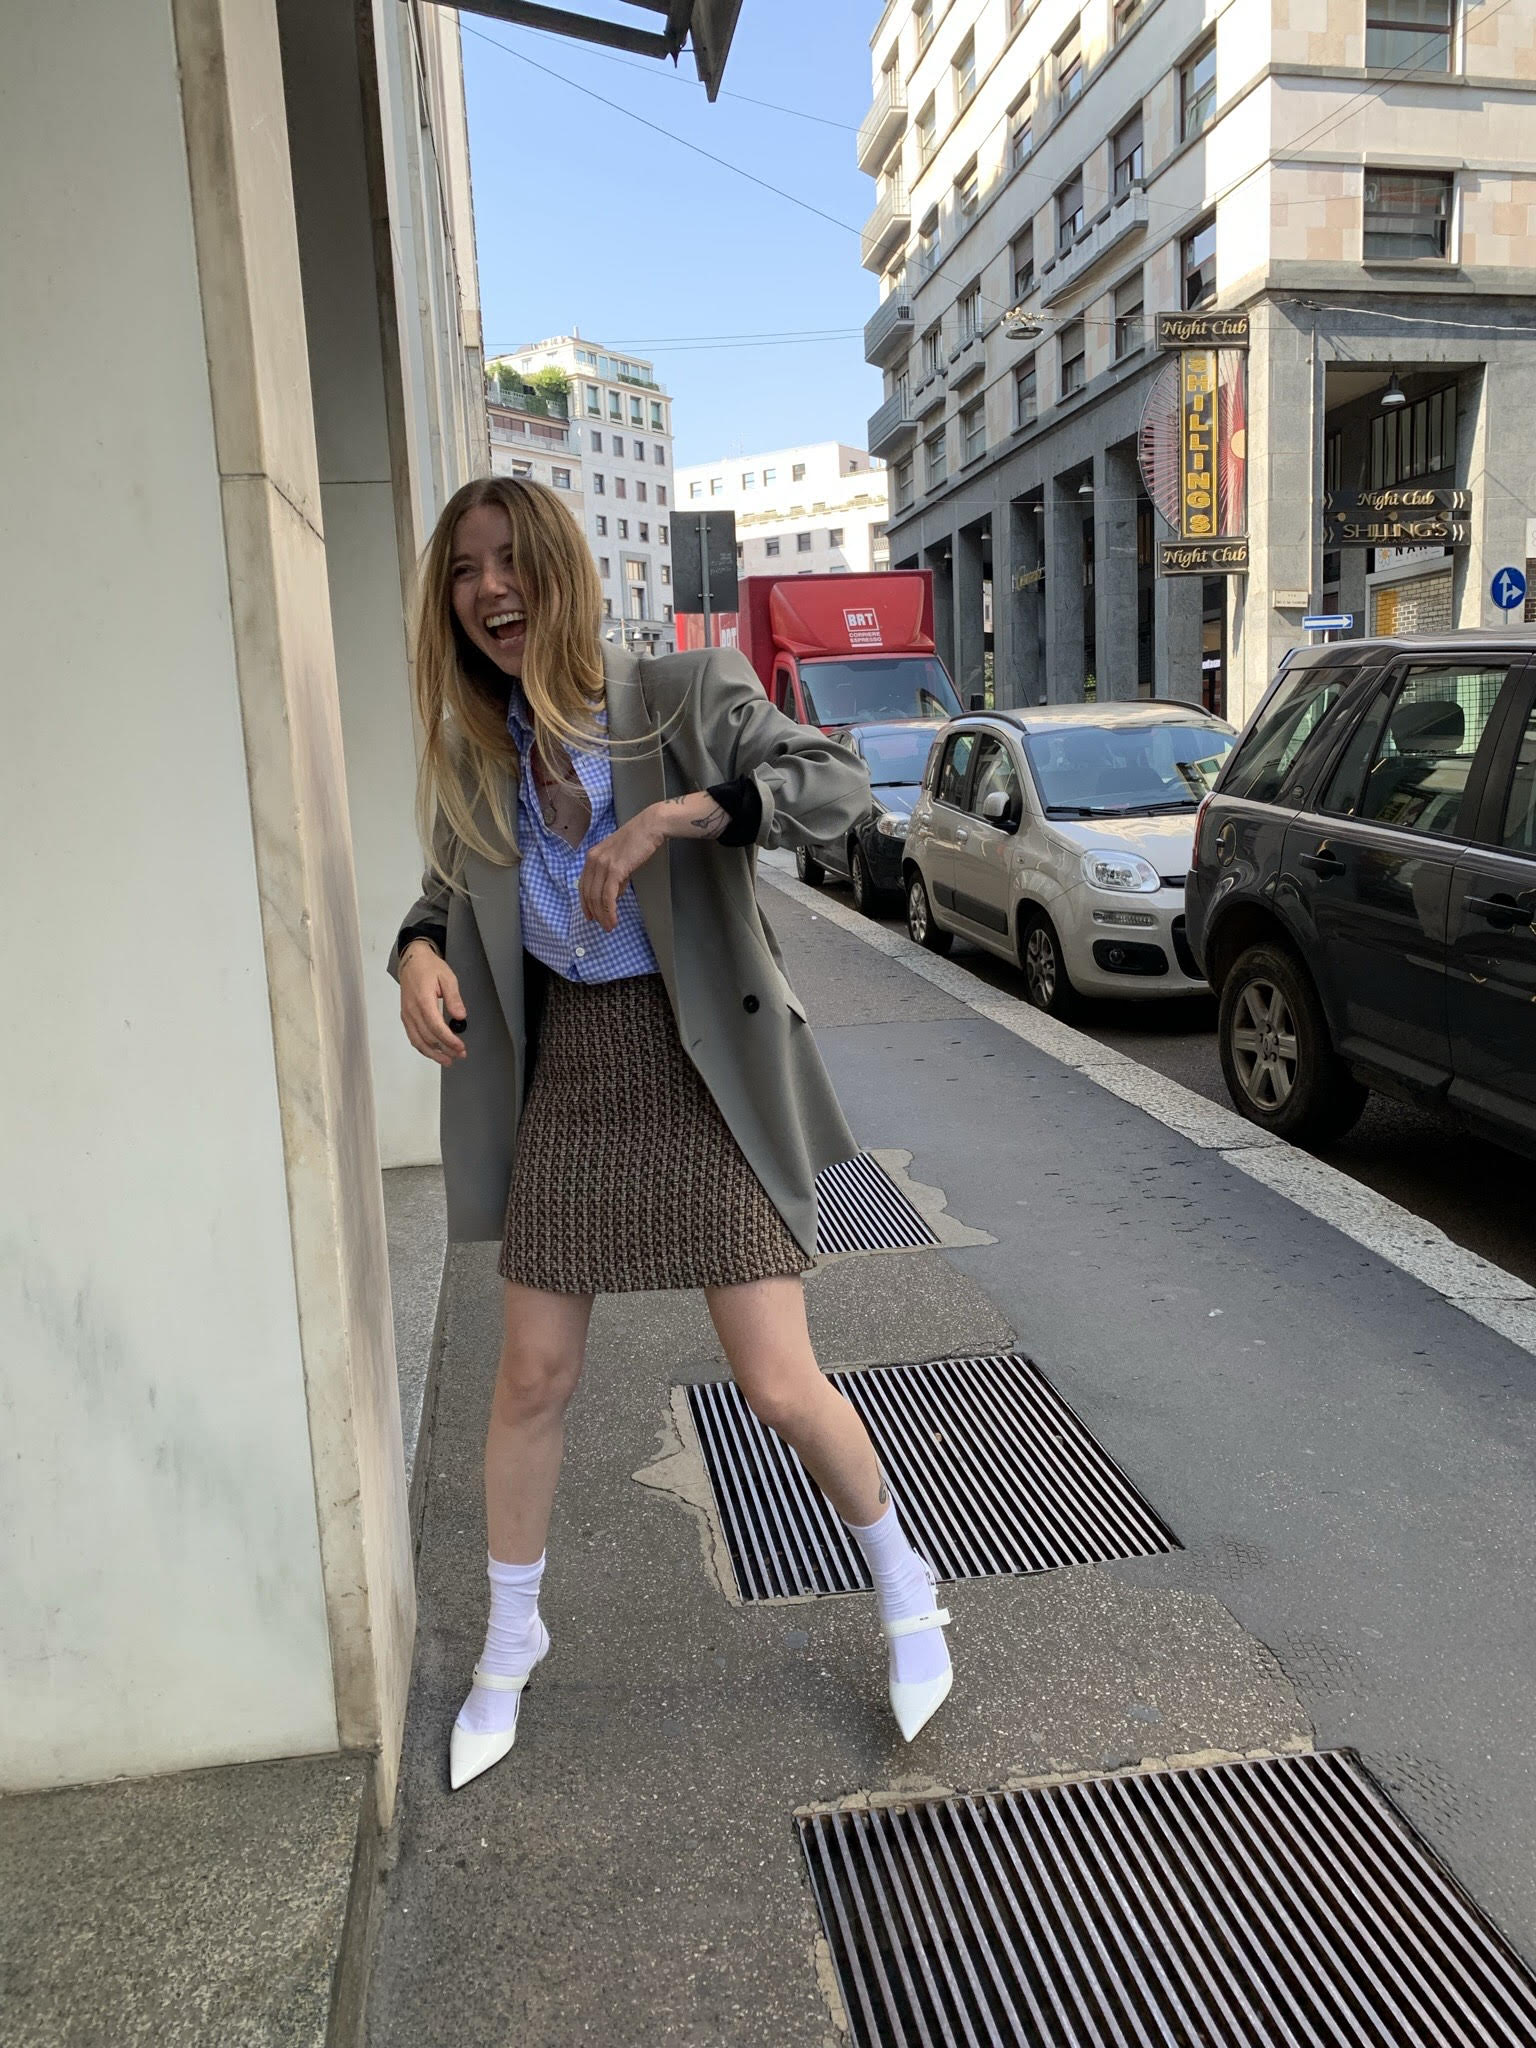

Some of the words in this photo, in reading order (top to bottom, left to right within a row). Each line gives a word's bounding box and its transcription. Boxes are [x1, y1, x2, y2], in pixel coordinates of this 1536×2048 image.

[1160, 319, 1208, 340] Night
[1211, 318, 1247, 335] Club
[1186, 355, 1211, 533] SHILLINGS
[1356, 490, 1400, 510] Night
[1402, 489, 1436, 505] Club
[1161, 547, 1208, 568] Night
[1212, 545, 1247, 562] Club
[847, 613, 873, 627] BRT
